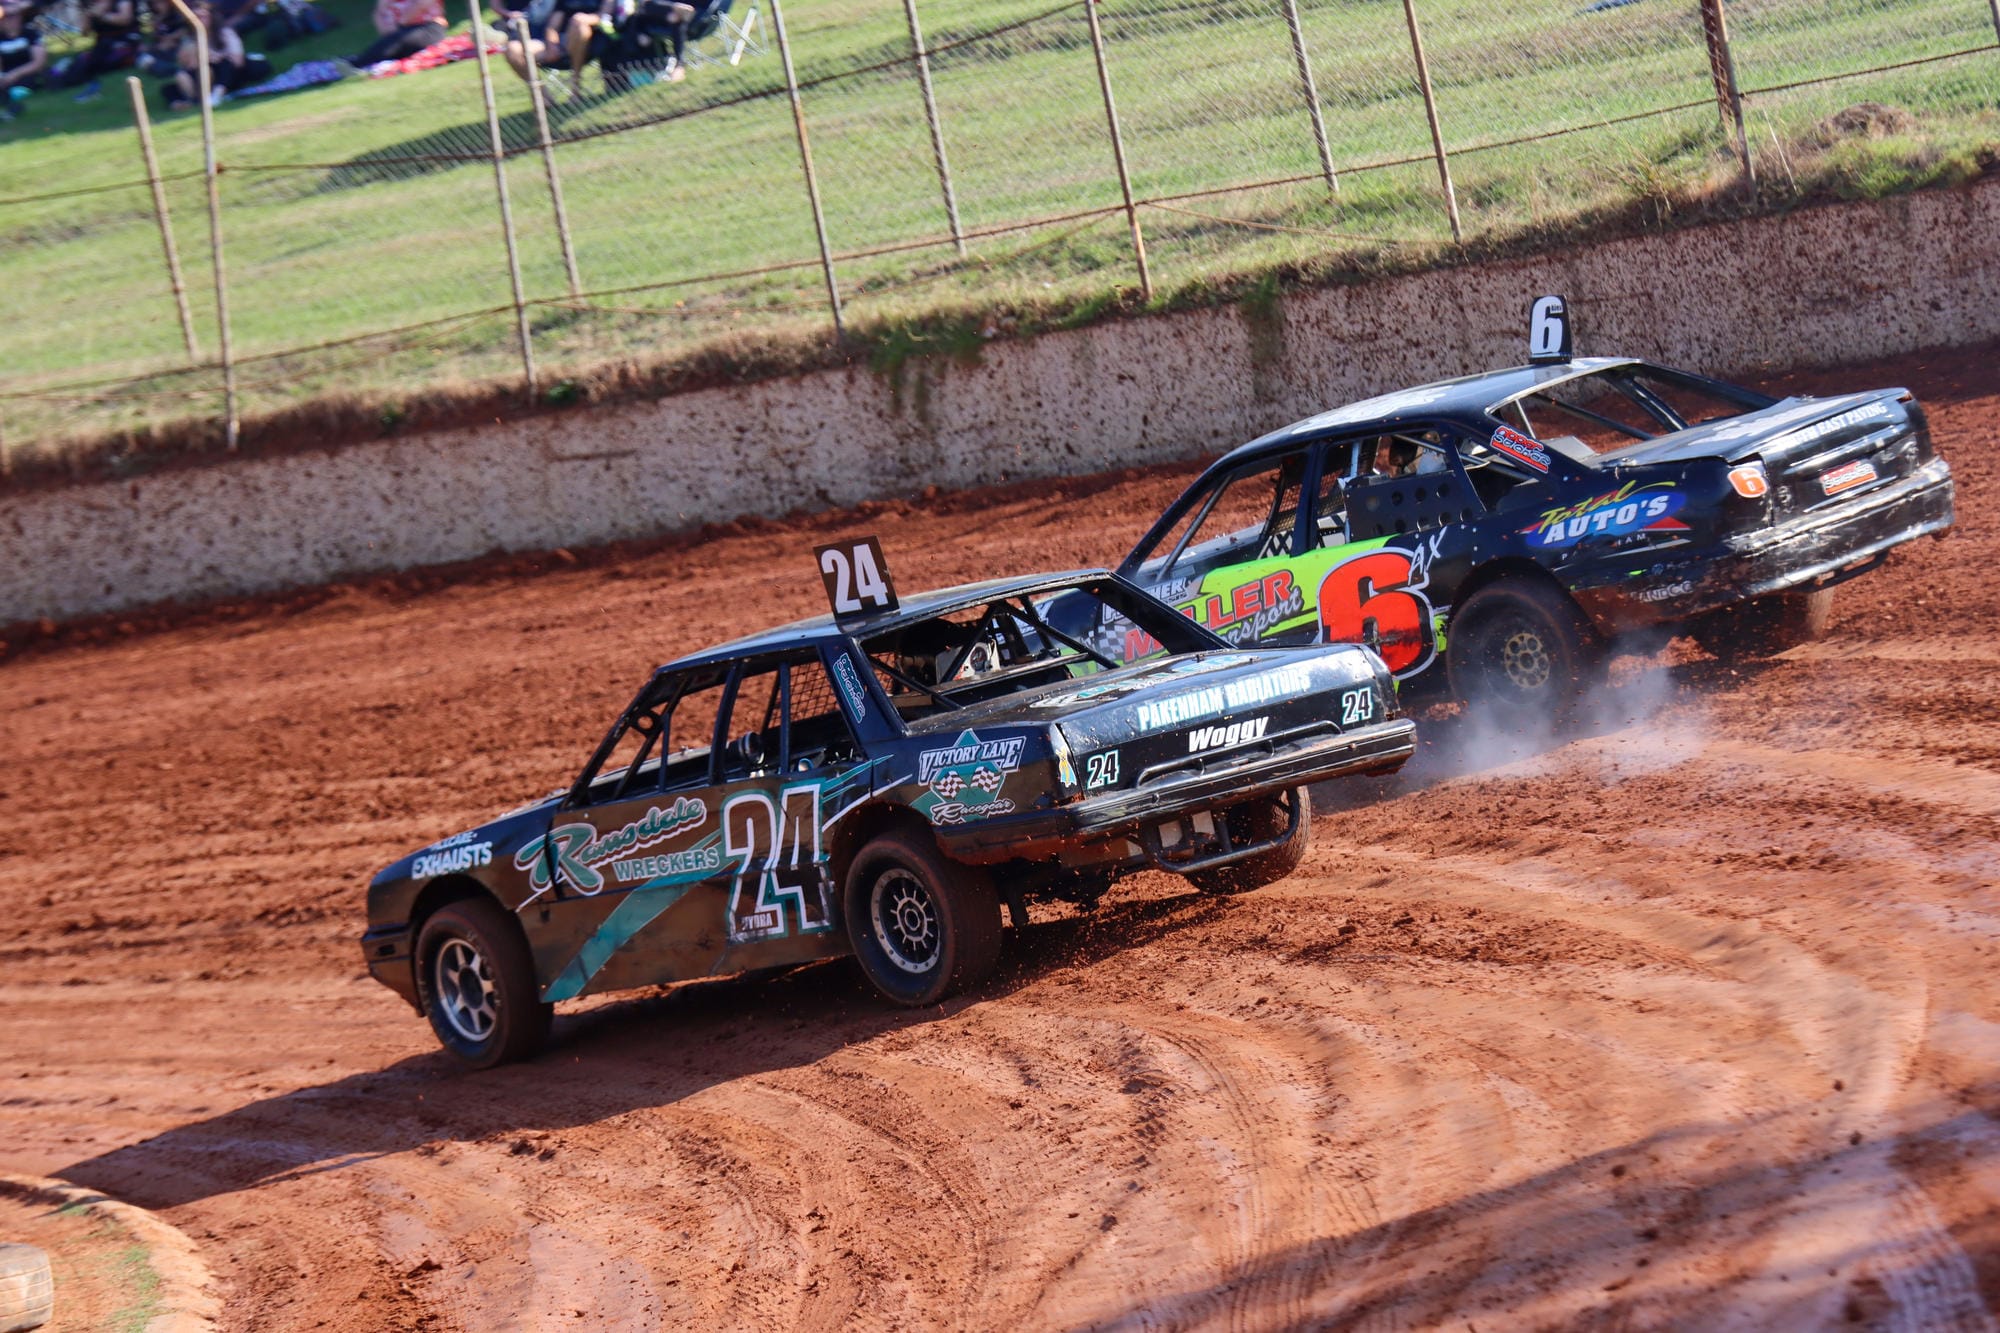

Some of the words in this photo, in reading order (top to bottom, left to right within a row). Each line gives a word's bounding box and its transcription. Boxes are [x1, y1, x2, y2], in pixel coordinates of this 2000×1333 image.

[1530, 296, 1563, 354] 6
[1817, 412, 1847, 437] EAST
[1848, 401, 1888, 425] PAVING
[1728, 467, 1767, 498] 6
[1538, 480, 1676, 534] Total
[1543, 495, 1670, 544] AUTO'S
[821, 544, 888, 614] 24
[1124, 570, 1293, 664] MLER
[1316, 546, 1438, 681] 6
[1137, 687, 1224, 732] PAKENHAM
[1223, 668, 1311, 706] RADIATORS
[1342, 687, 1373, 725] 24
[1188, 716, 1269, 753] Woggy
[920, 745, 981, 783] VICTORY
[982, 738, 1022, 769] LANE
[1087, 749, 1119, 789] 24
[931, 799, 1014, 825] Racegear
[411, 841, 493, 880] EXHAUSTS
[613, 848, 720, 882] WRECKERS
[722, 781, 831, 937] 24
